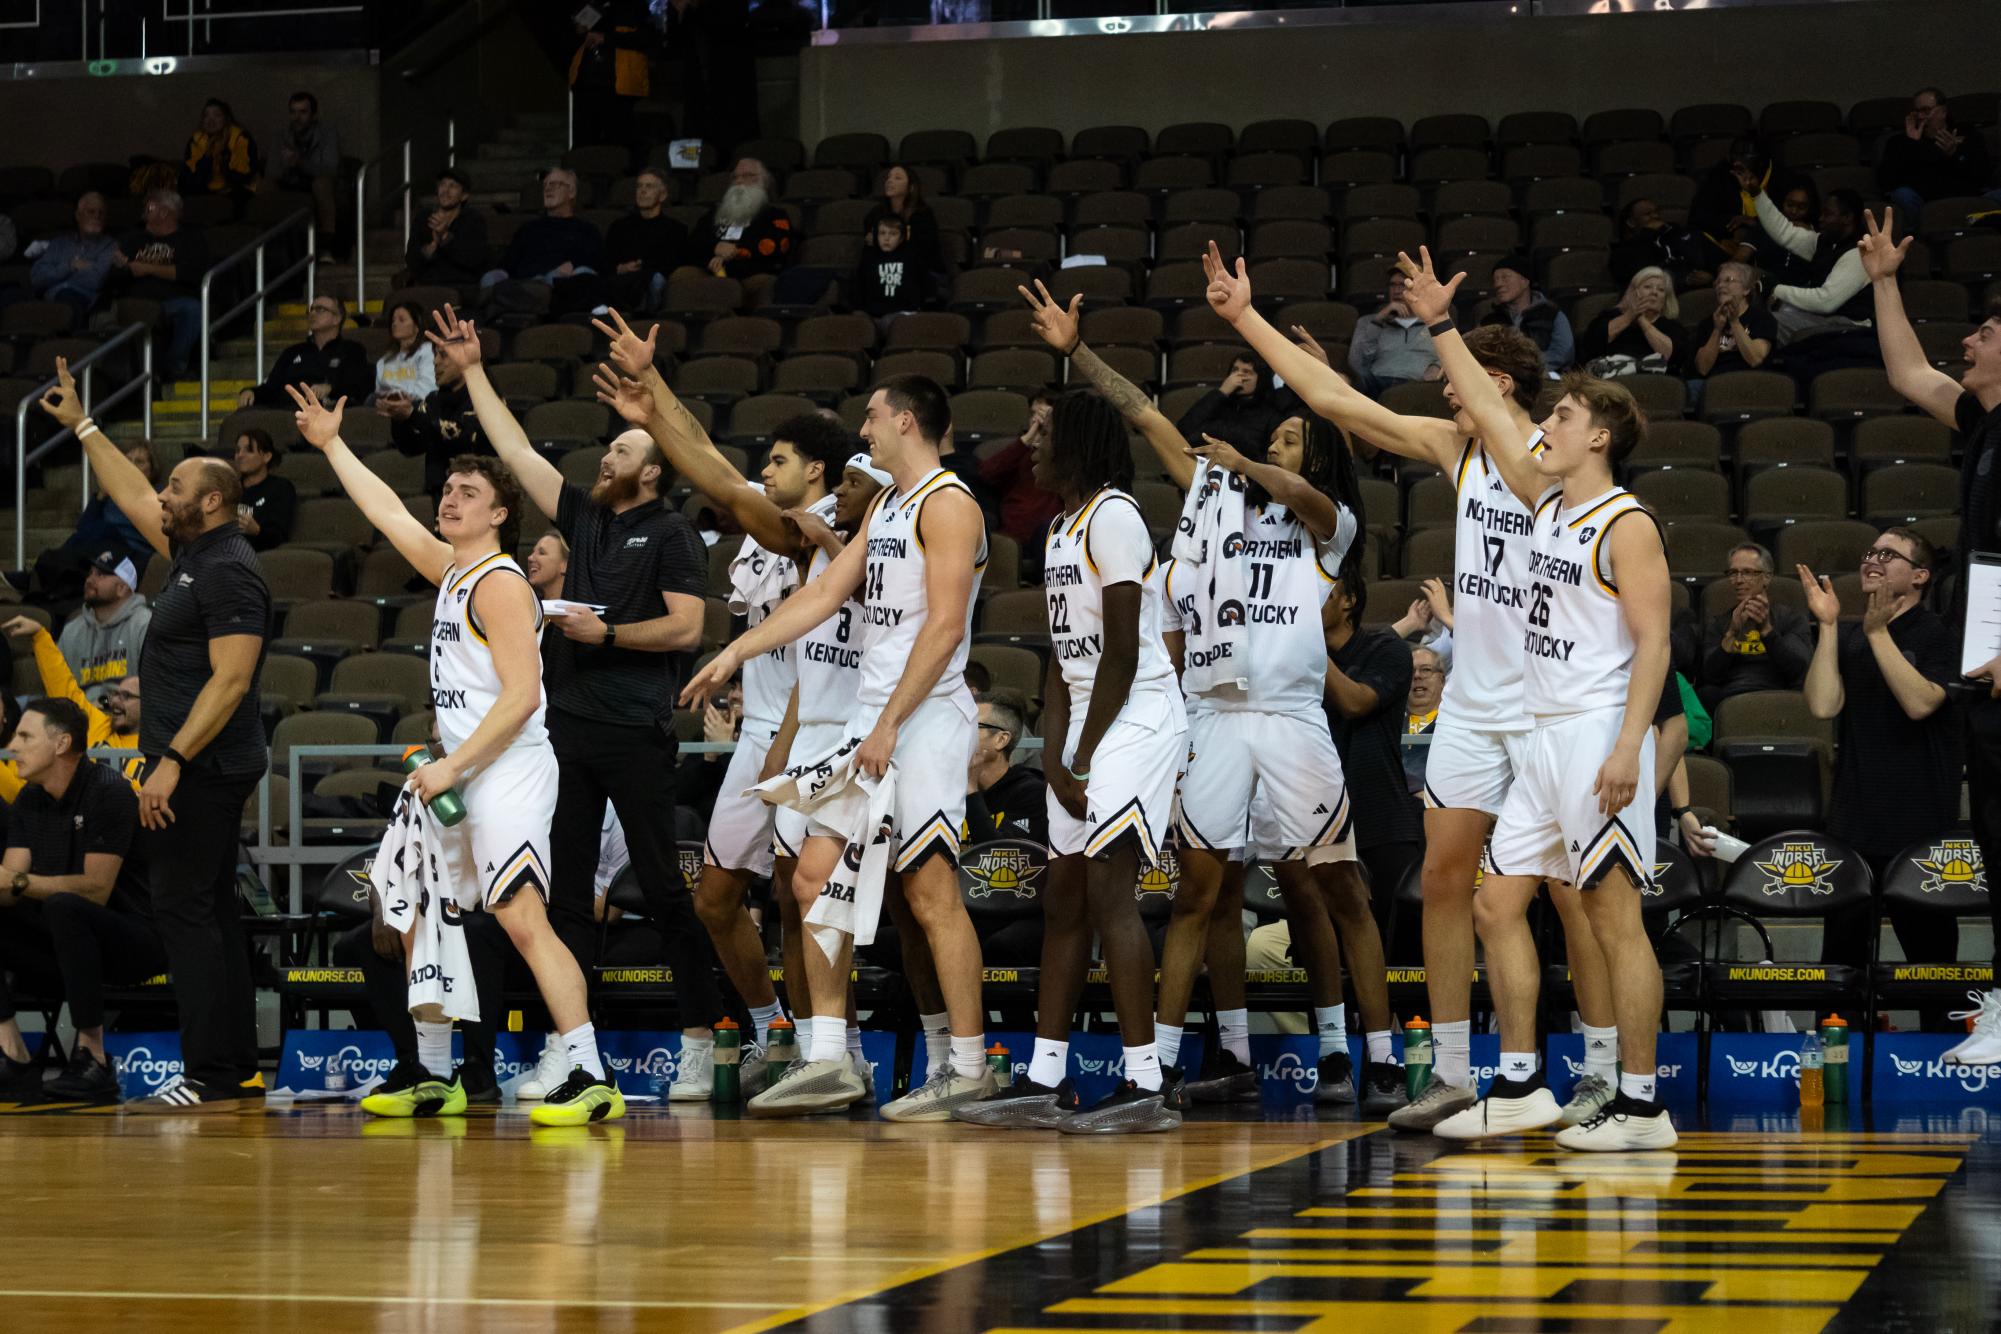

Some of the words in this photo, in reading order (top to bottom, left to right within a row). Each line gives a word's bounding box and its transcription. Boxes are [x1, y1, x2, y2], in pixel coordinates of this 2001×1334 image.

[878, 262, 904, 273] LIVE
[879, 273, 902, 286] FOR
[884, 285, 896, 296] IT
[1466, 498, 1533, 536] NOTHERN
[868, 538, 906, 558] ORTHERN
[1241, 539, 1302, 559] ORTHERN
[1529, 549, 1583, 586] ORTHERN
[1249, 563, 1274, 599] 11
[1459, 572, 1527, 609] KENTUCK
[1050, 593, 1071, 634] 22
[1248, 604, 1299, 625] TUCKY
[1528, 581, 1553, 628] 26
[836, 607, 852, 643] 8
[804, 641, 863, 669] KENTUC
[1774, 852, 1823, 866] NORSE
[602, 970, 673, 983] NKUNORSE.C
[1245, 970, 1309, 983] UNORSE.CO
[1729, 968, 1825, 981] NKUNORSE.COM
[1894, 968, 1994, 981] NKUNORSE.COM
[326, 1045, 399, 1085] Kroger
[1263, 1053, 1319, 1094] Krog
[1926, 1056, 2001, 1092] Kroge
